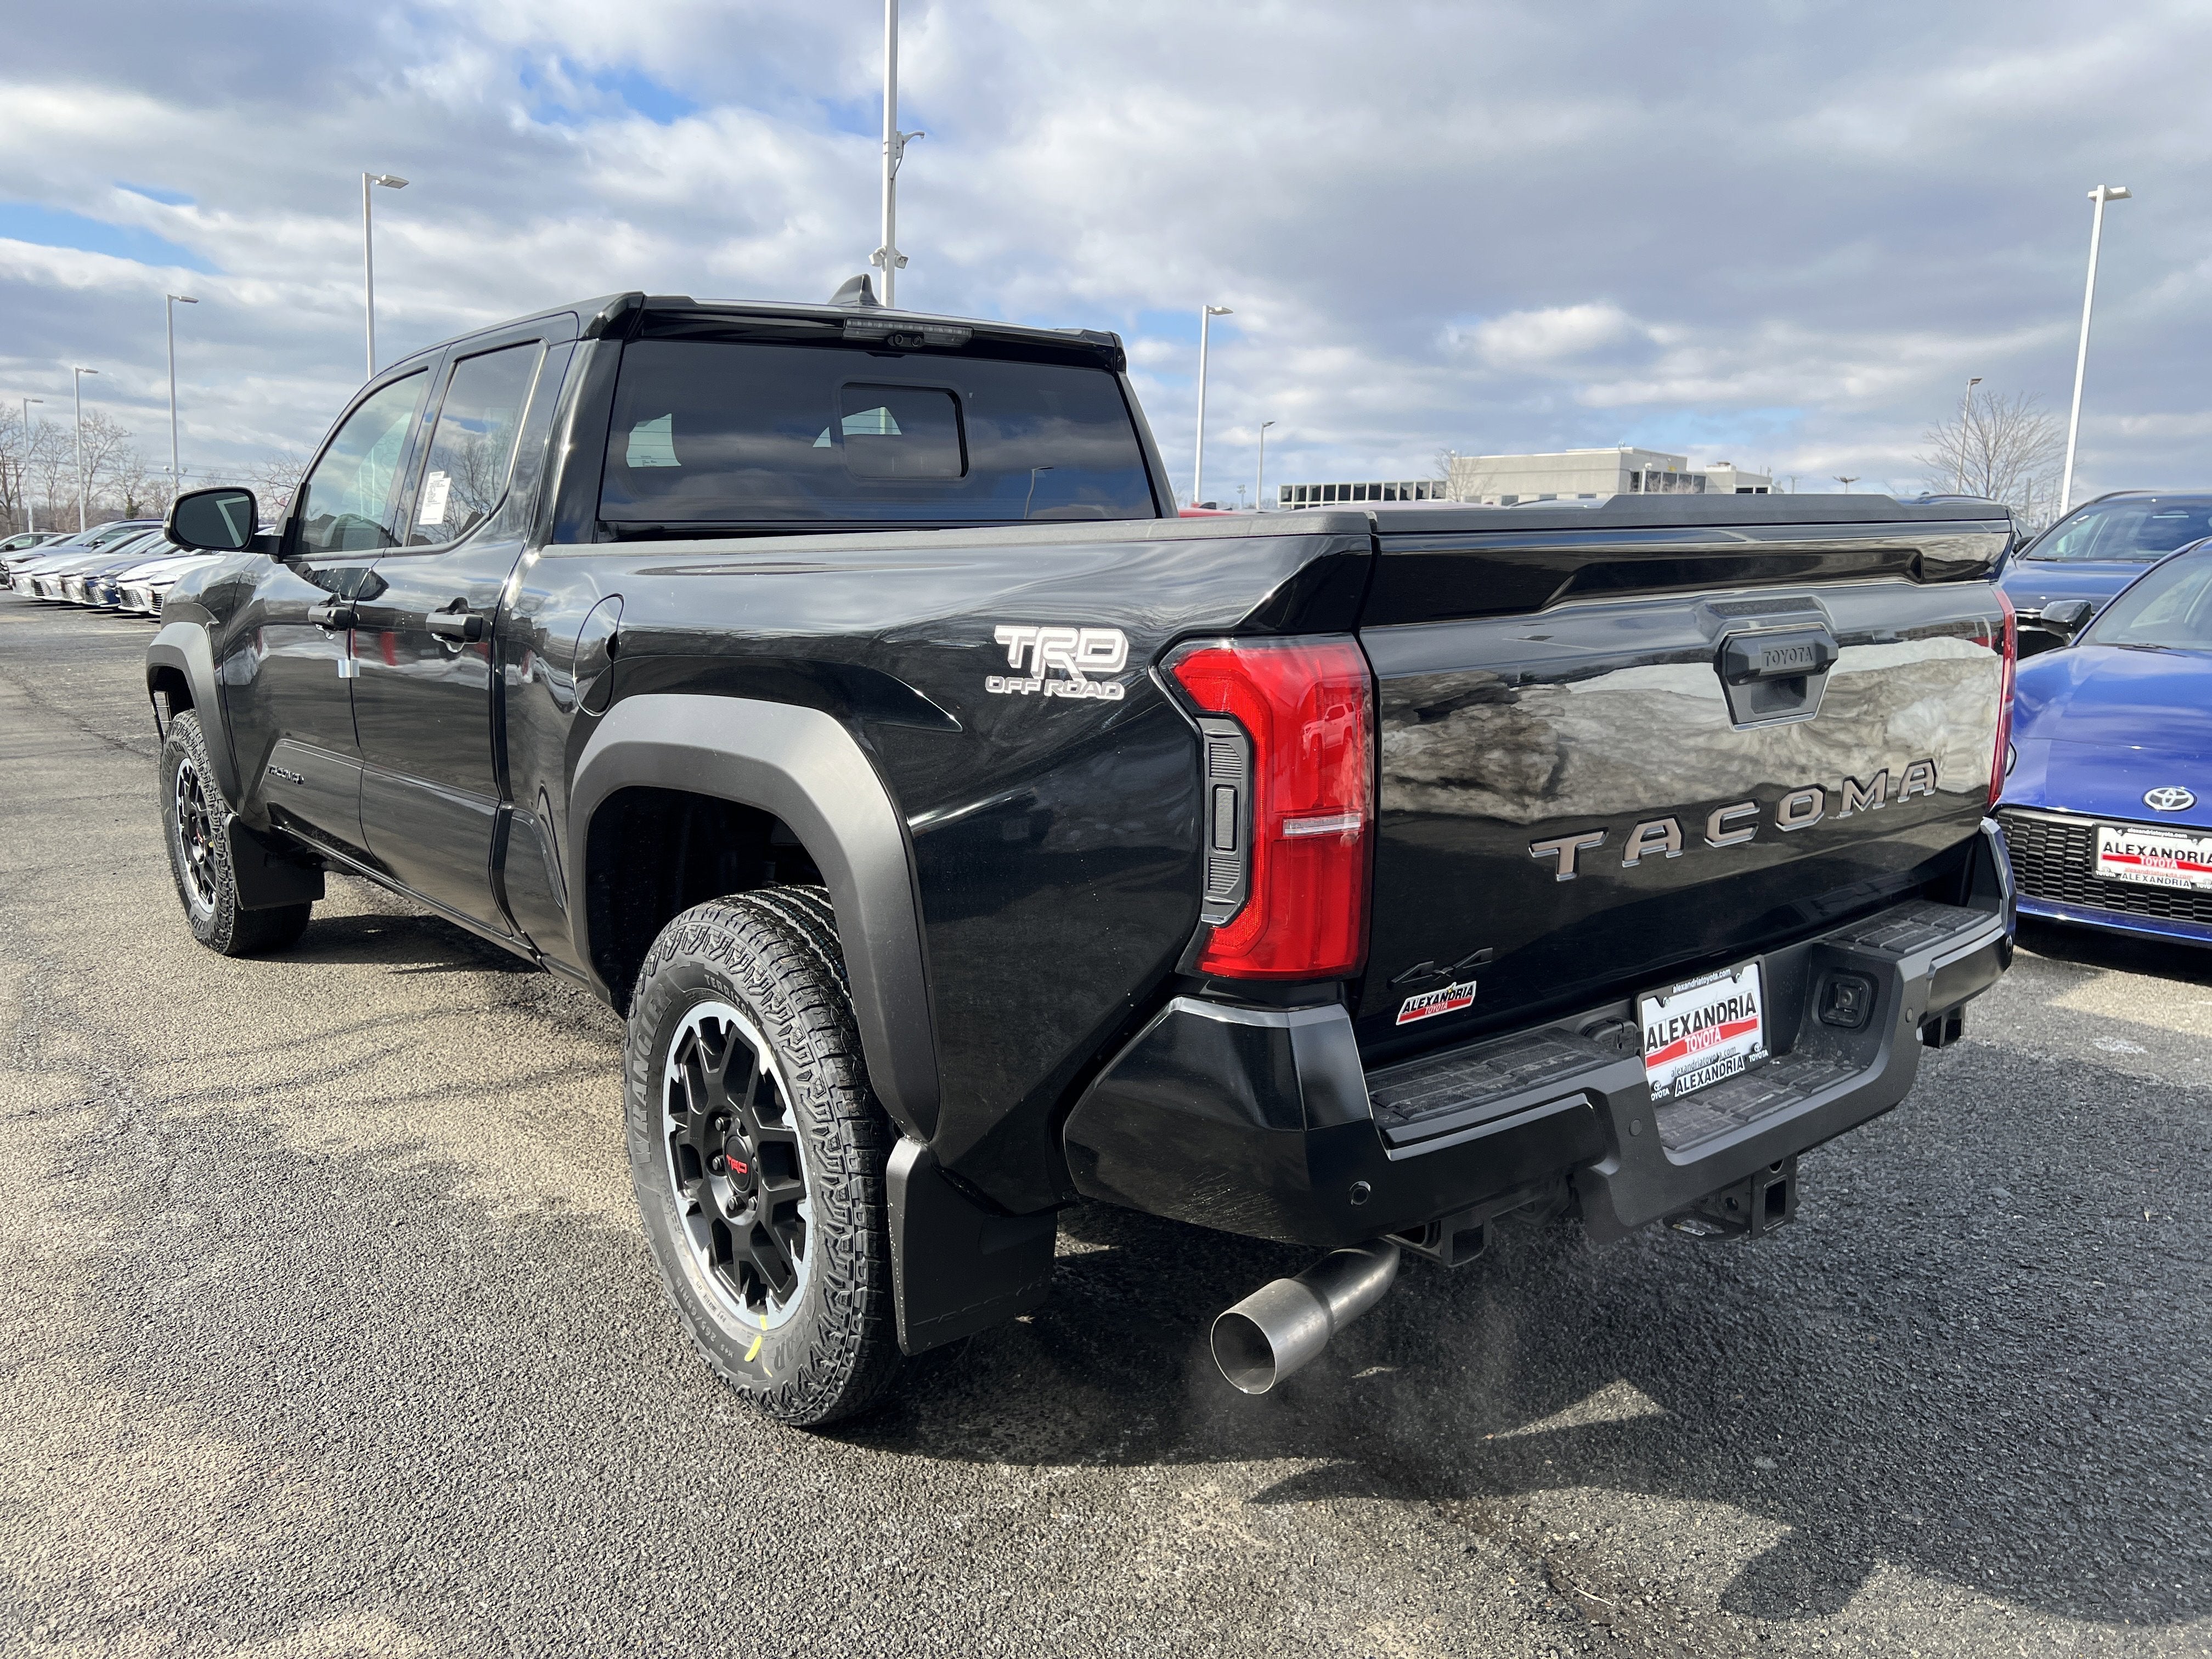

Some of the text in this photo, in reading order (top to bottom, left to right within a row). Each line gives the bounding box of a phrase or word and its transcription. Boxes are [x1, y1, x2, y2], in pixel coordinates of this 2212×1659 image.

[994, 625, 1128, 681] TRD
[1763, 646, 1813, 667] TOYOTA
[985, 675, 1125, 700] OFF ROAD
[1528, 758, 1938, 882] TACOMA
[2139, 855, 2179, 869] TOYOTA
[2121, 873, 2190, 887] ALEXANDRIA
[1672, 968, 1731, 993] alexandriatoyota.com
[1402, 985, 1474, 1014] ALEXANDRIA
[1424, 1001, 1449, 1015] TOYOTA
[1646, 991, 1757, 1052] ALEXANDRIA
[1684, 1027, 1722, 1053] TOYOTA
[1748, 1048, 1769, 1063] TOYOTA
[632, 983, 672, 1165] WRANGLER
[1675, 1054, 1744, 1096] ALEXANDRIA
[1650, 1087, 1670, 1102] OYOTA
[726, 1154, 748, 1174] TRD
